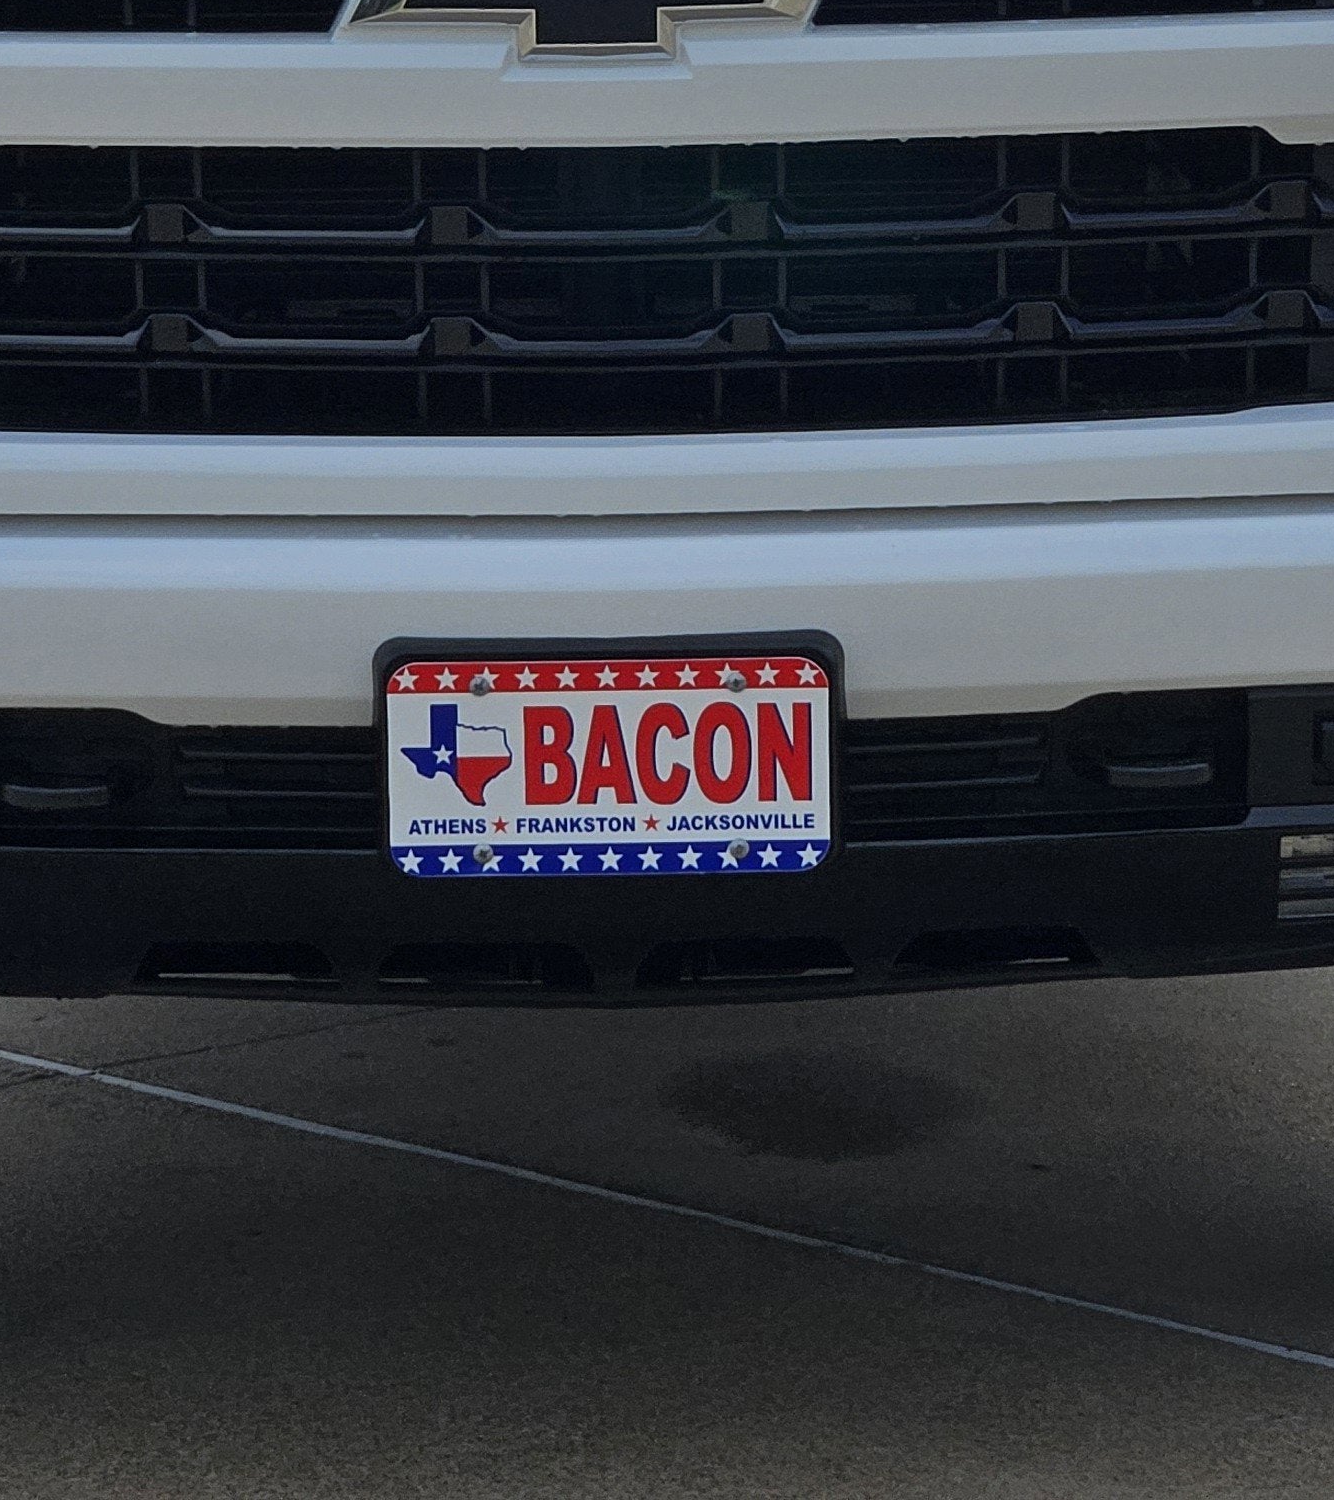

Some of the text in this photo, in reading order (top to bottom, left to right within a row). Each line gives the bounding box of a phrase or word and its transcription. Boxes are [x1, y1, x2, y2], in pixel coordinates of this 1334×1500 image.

[522, 701, 813, 806] BACON
[408, 812, 816, 835] ATHENS FRANKSTON JACKSONVILLE
